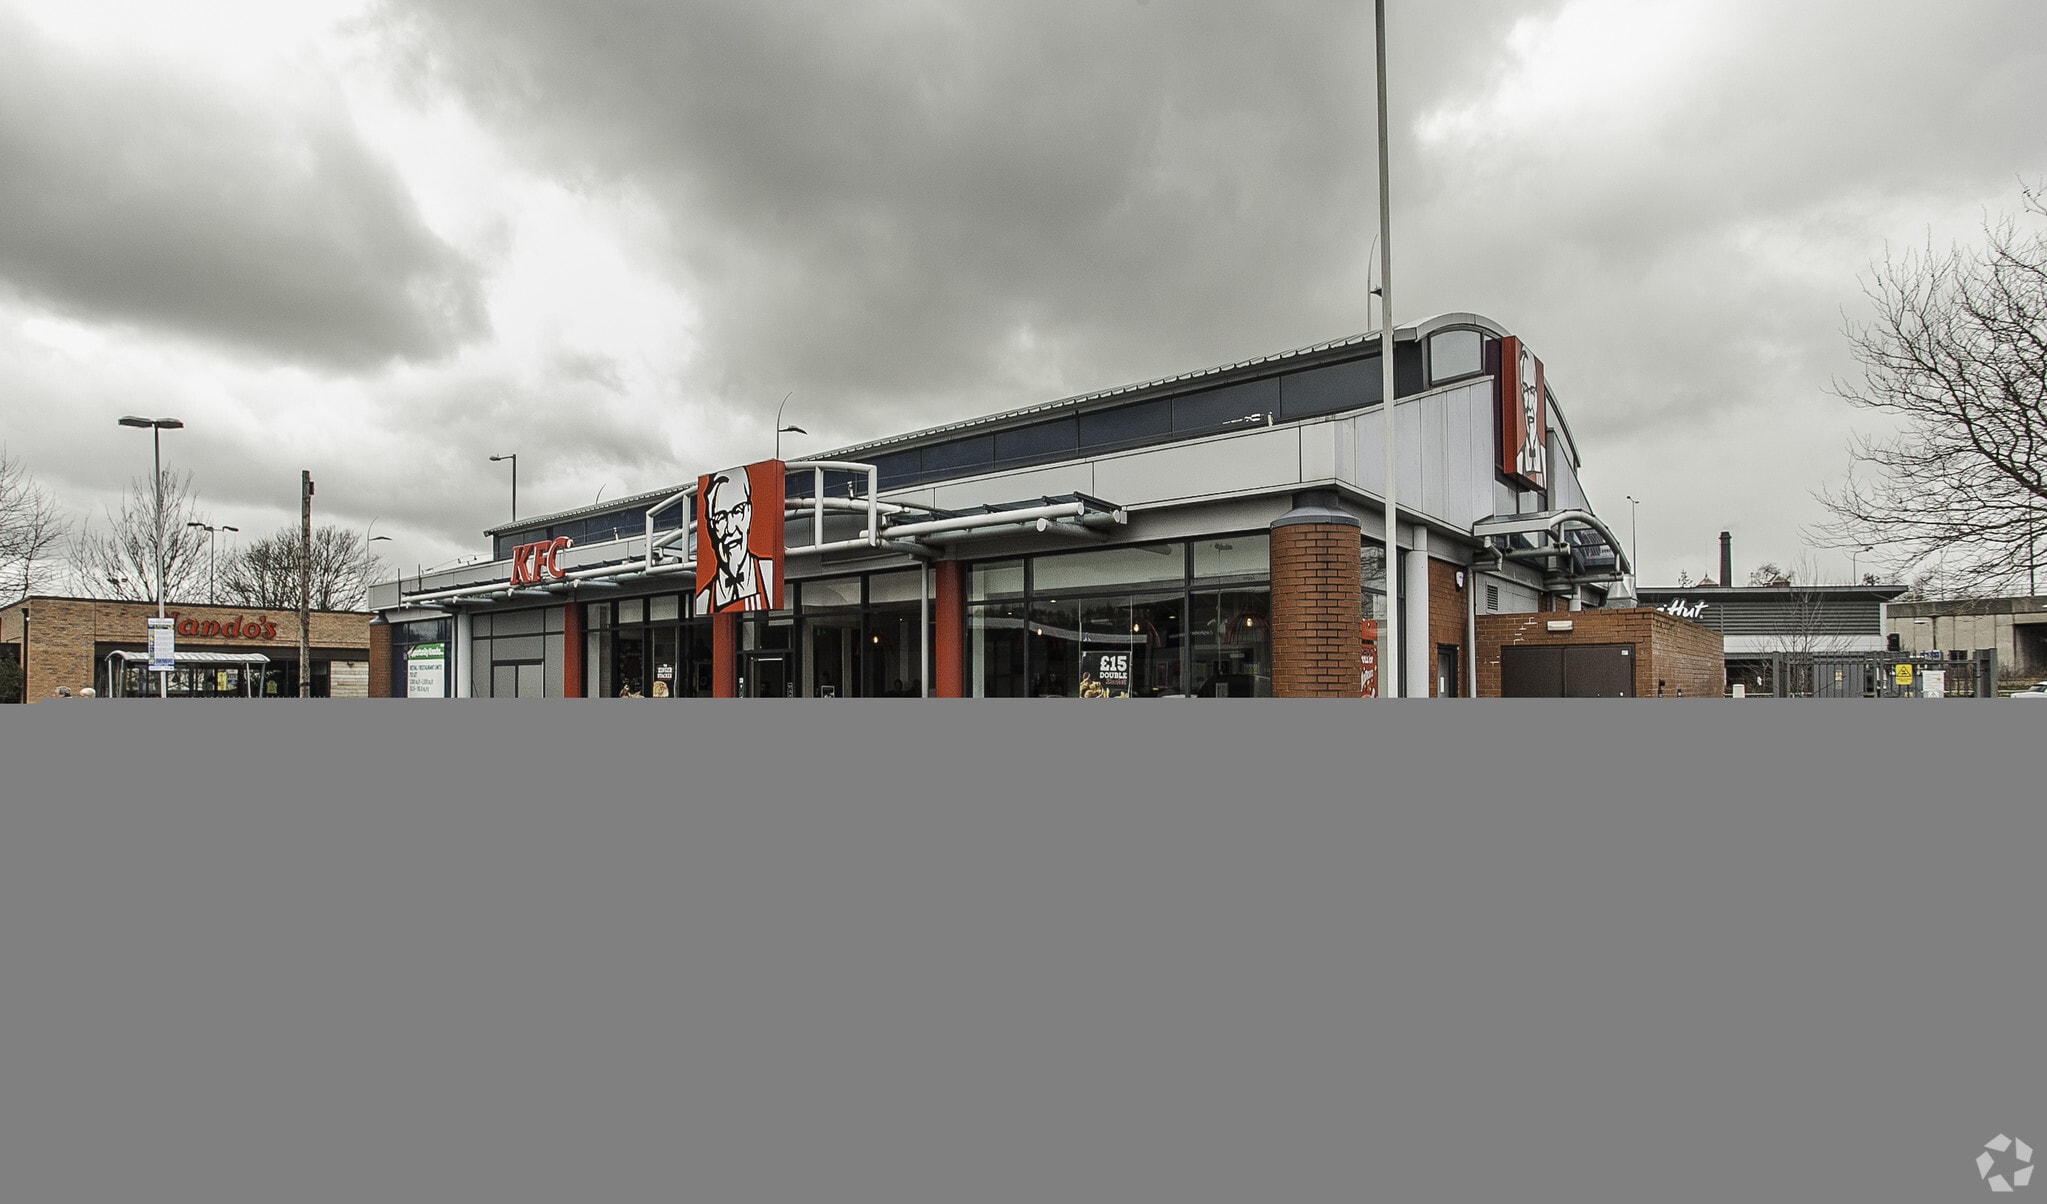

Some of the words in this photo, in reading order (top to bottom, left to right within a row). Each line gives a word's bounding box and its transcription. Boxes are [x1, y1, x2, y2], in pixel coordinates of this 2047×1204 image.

[510, 536, 571, 585] KFC
[1667, 599, 1709, 618] Hut
[1100, 655, 1128, 672] £15
[1099, 671, 1128, 679] DOUBLE
